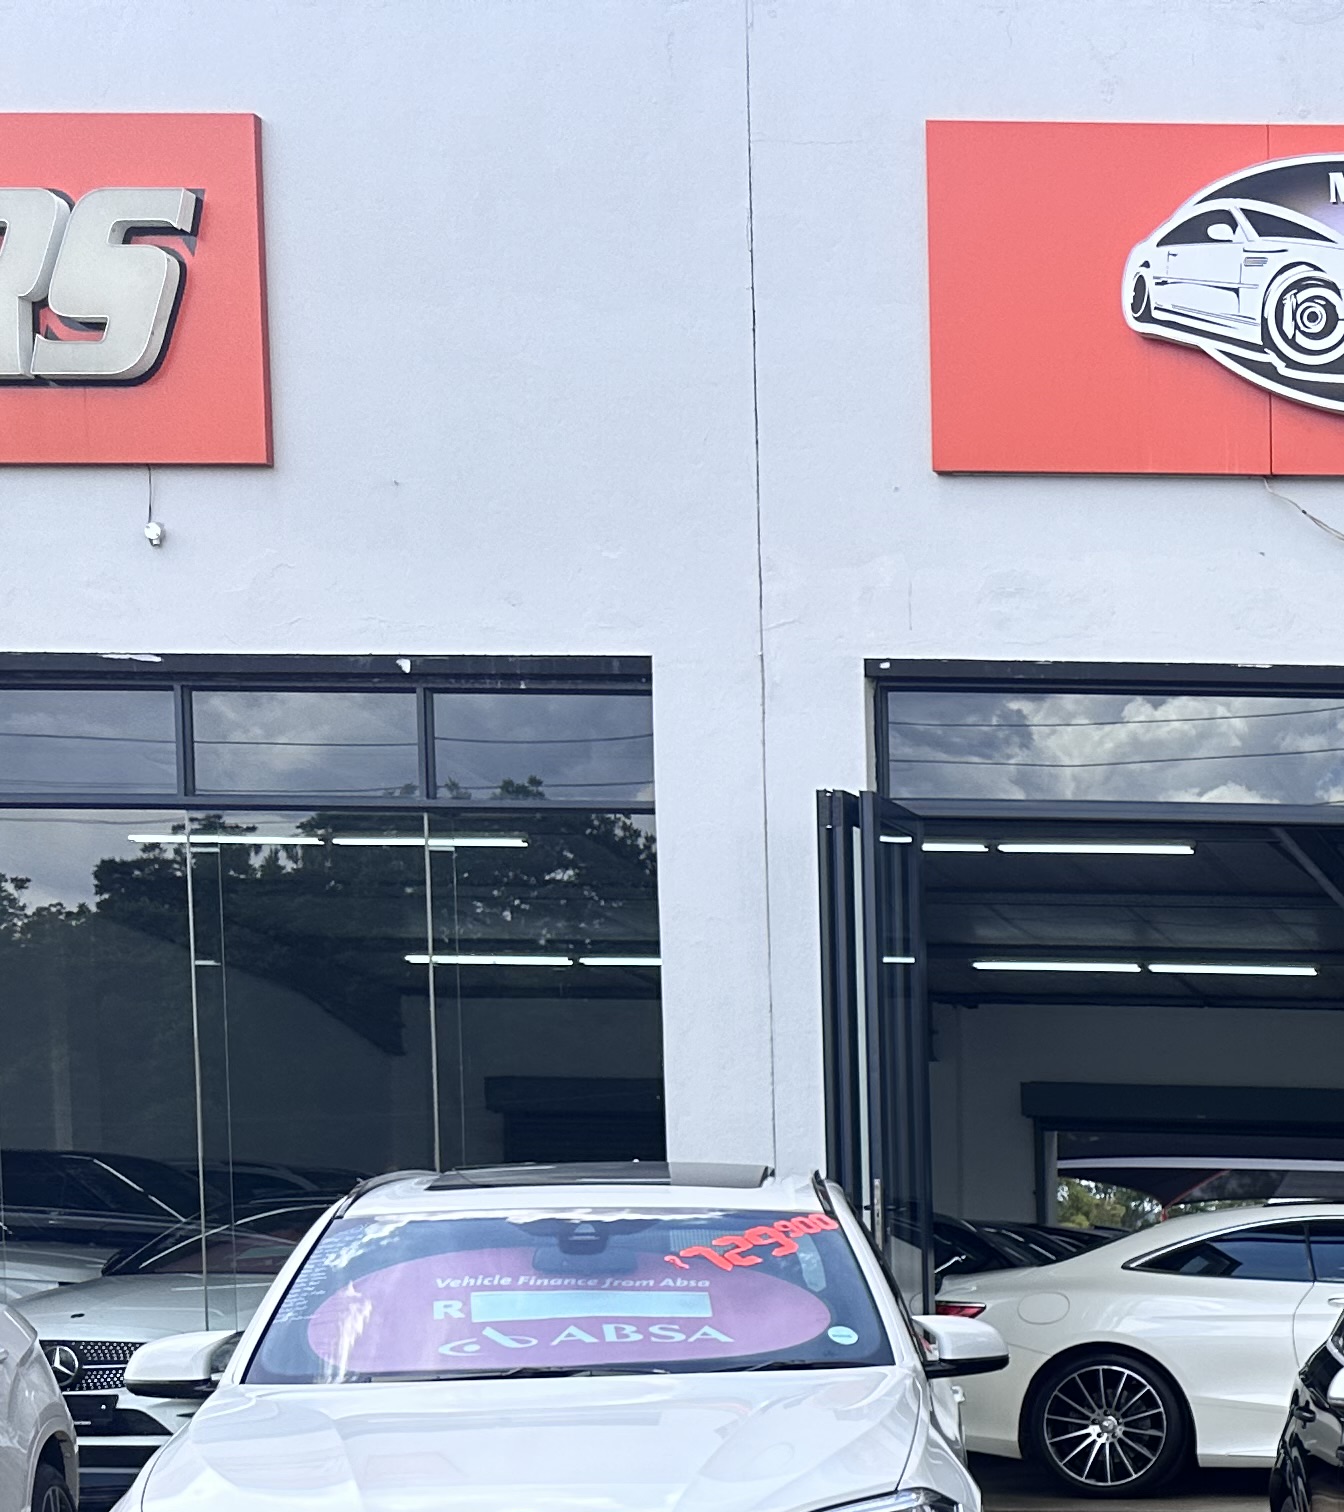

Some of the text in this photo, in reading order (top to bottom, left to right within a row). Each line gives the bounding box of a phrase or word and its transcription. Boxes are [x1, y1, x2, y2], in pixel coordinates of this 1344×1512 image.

[436, 1274, 711, 1289] Vehicle Finance from Absa
[432, 1299, 465, 1320] R
[549, 1322, 735, 1346] ABSA
